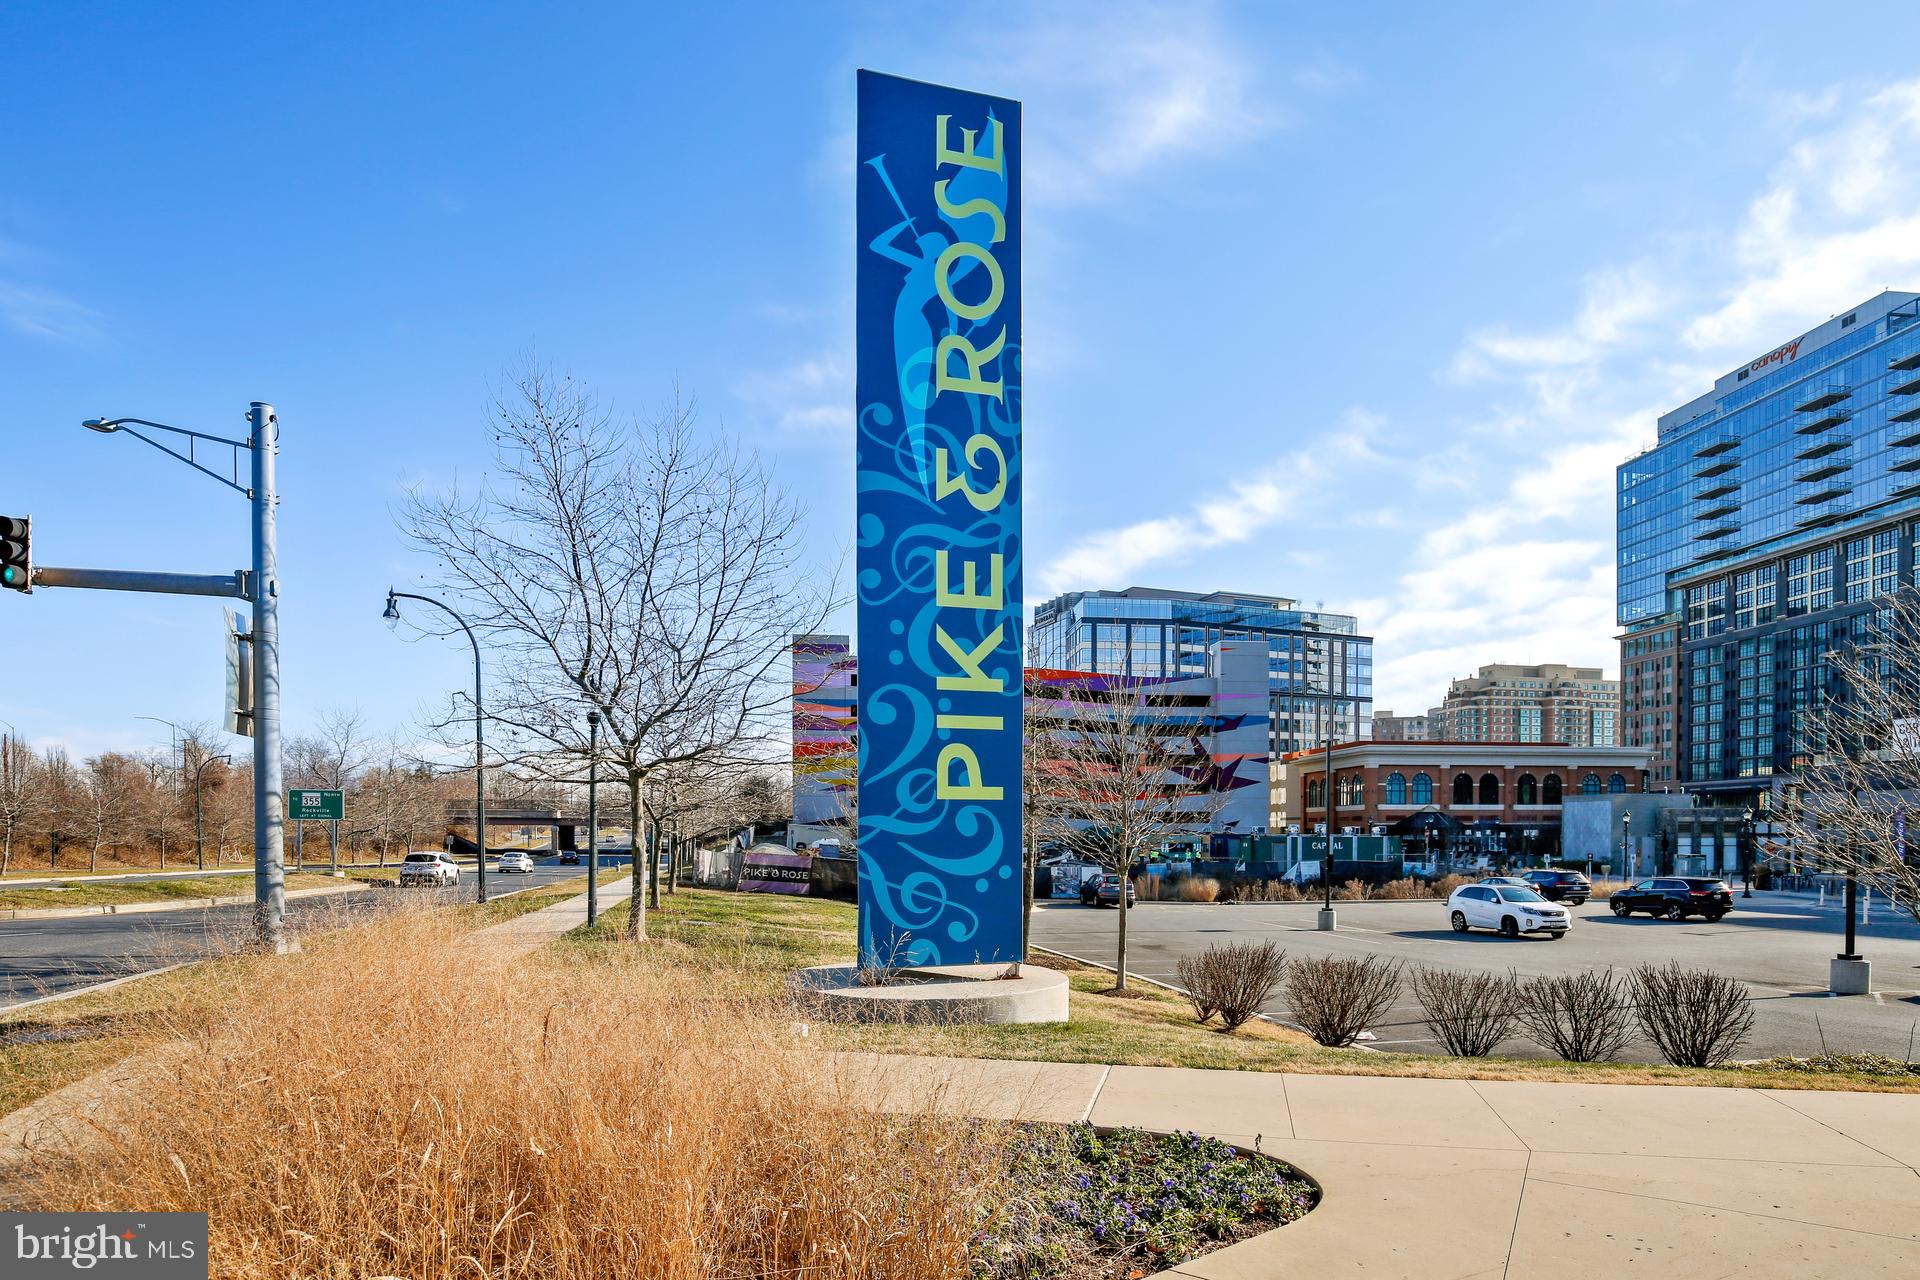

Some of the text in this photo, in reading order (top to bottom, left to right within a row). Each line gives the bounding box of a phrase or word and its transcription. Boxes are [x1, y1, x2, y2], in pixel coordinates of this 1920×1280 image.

[934, 114, 1006, 406] ROSE
[1750, 336, 1805, 371] canopy
[936, 550, 1004, 801] PIKE
[303, 797, 320, 806] 355
[1311, 841, 1344, 850] CAPAL
[744, 867, 769, 877] PIKE
[781, 870, 809, 880] ROSE
